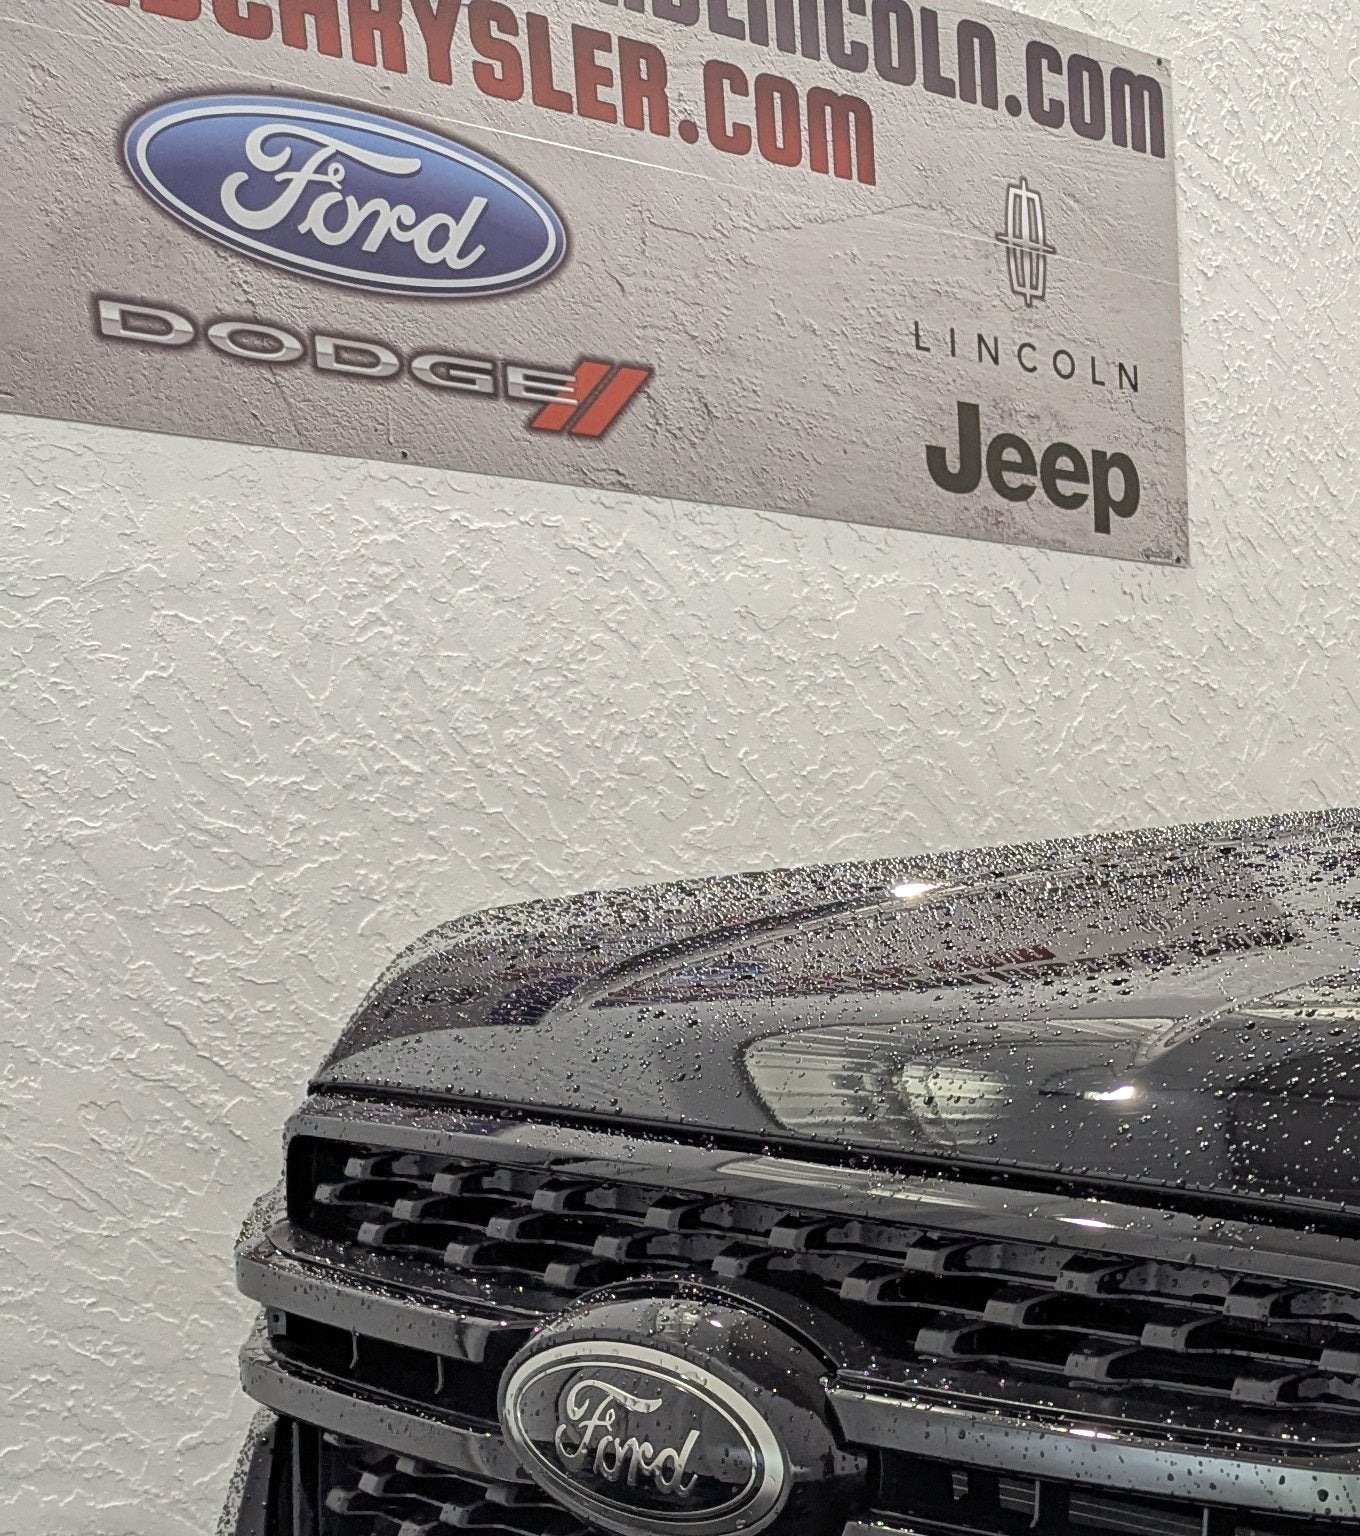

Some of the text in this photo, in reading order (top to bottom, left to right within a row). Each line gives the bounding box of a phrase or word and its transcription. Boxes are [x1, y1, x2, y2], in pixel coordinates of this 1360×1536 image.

[104, 0, 876, 187] HRYSLER.COM
[603, 0, 1166, 159] INCOLN.COM
[220, 122, 488, 271] Ford
[100, 300, 580, 406] DODGE
[914, 320, 1138, 393] LINCOLN
[925, 400, 1140, 535] Jeep
[555, 1379, 700, 1498] Ford
